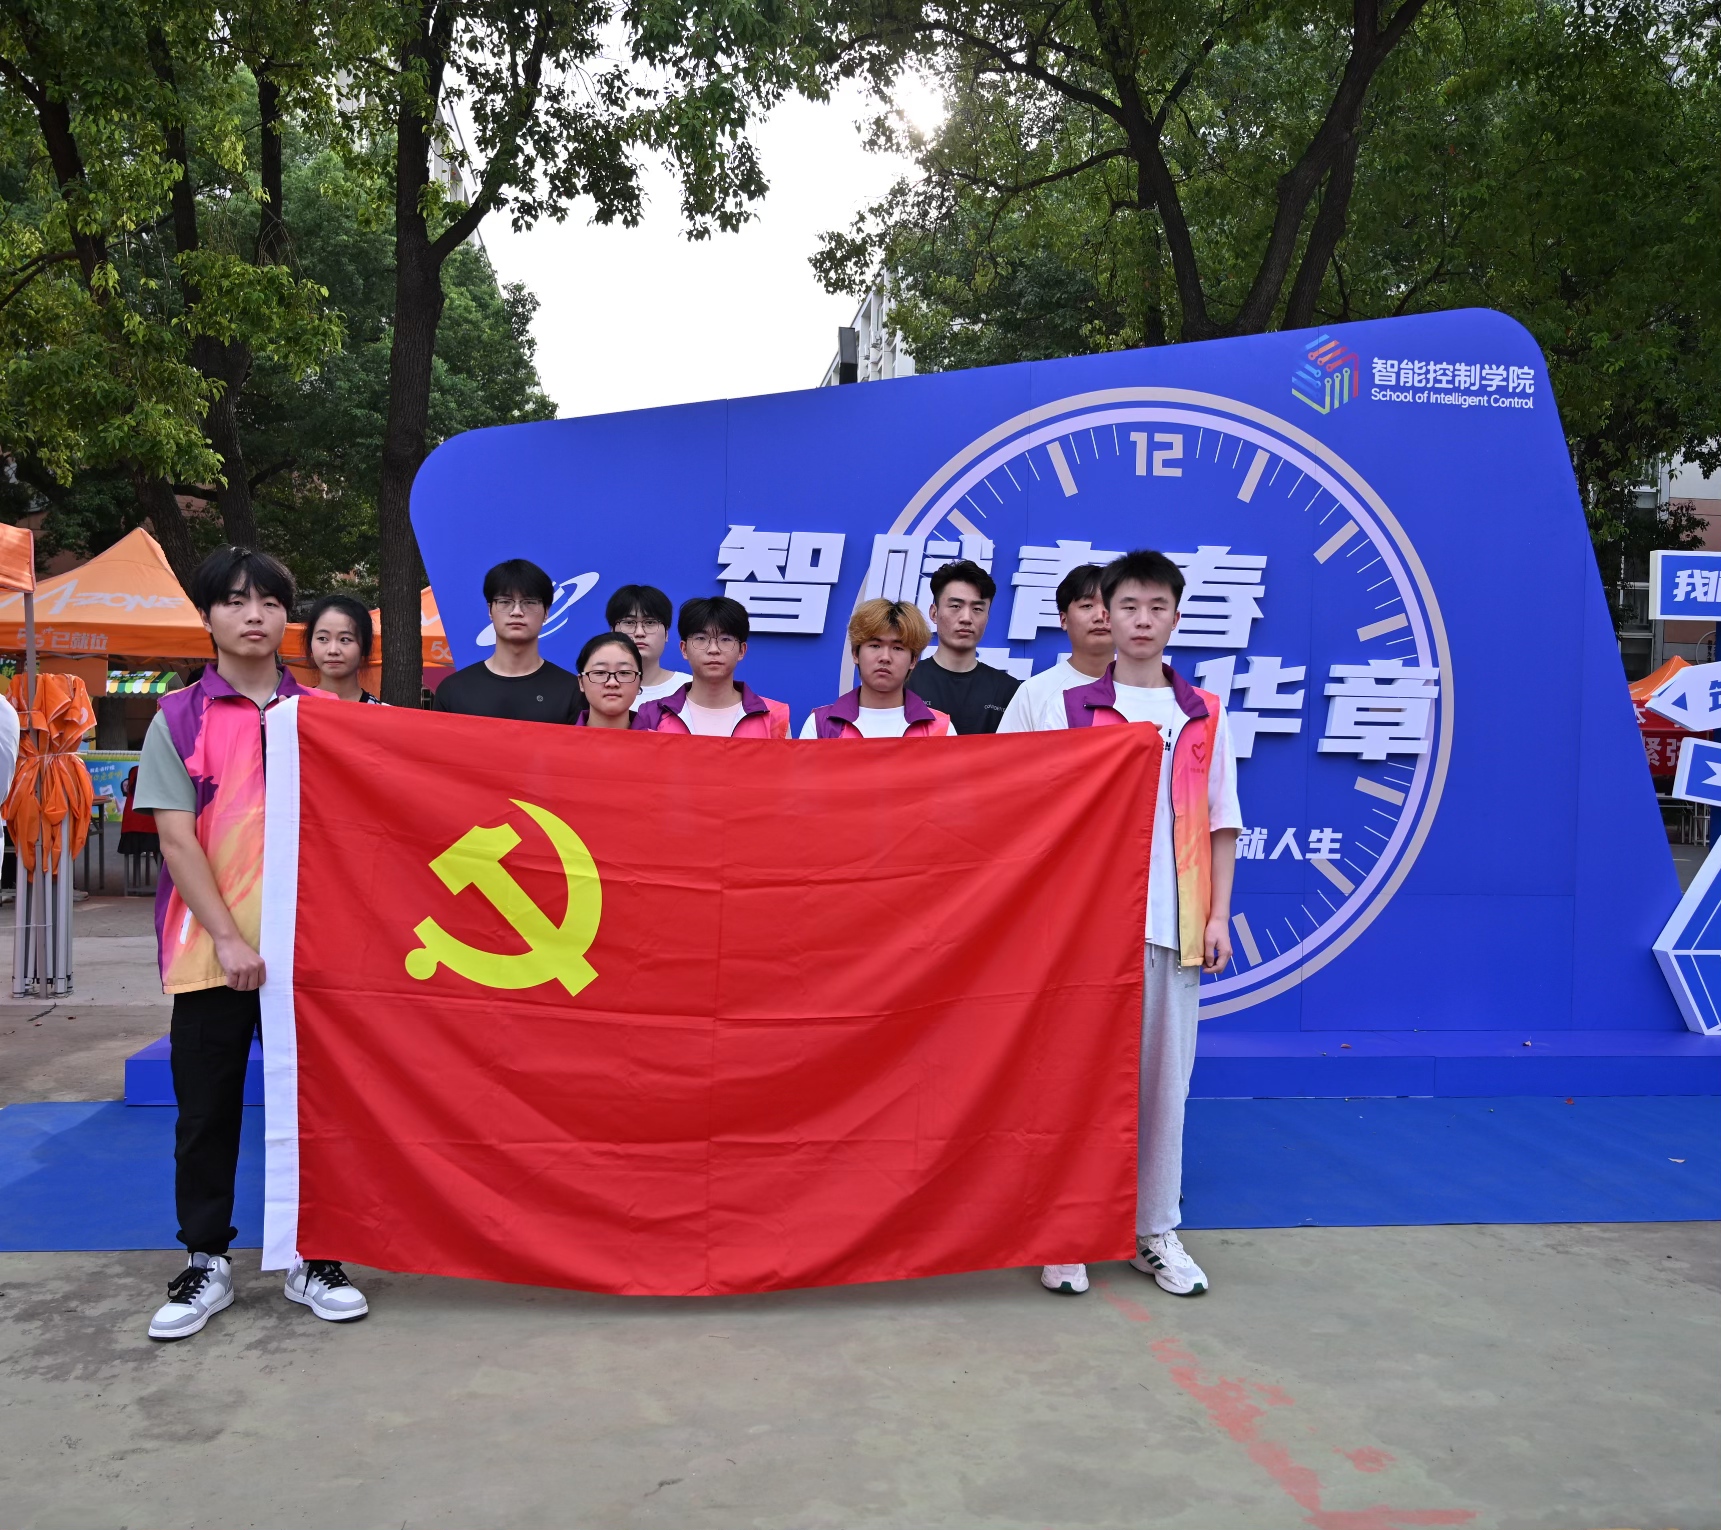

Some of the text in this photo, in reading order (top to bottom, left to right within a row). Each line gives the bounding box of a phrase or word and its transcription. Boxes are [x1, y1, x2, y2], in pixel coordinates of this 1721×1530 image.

[1371, 357, 1535, 394] 智能控制学院
[1371, 388, 1534, 409] School of Intelligent Control
[1129, 431, 1184, 478] 12
